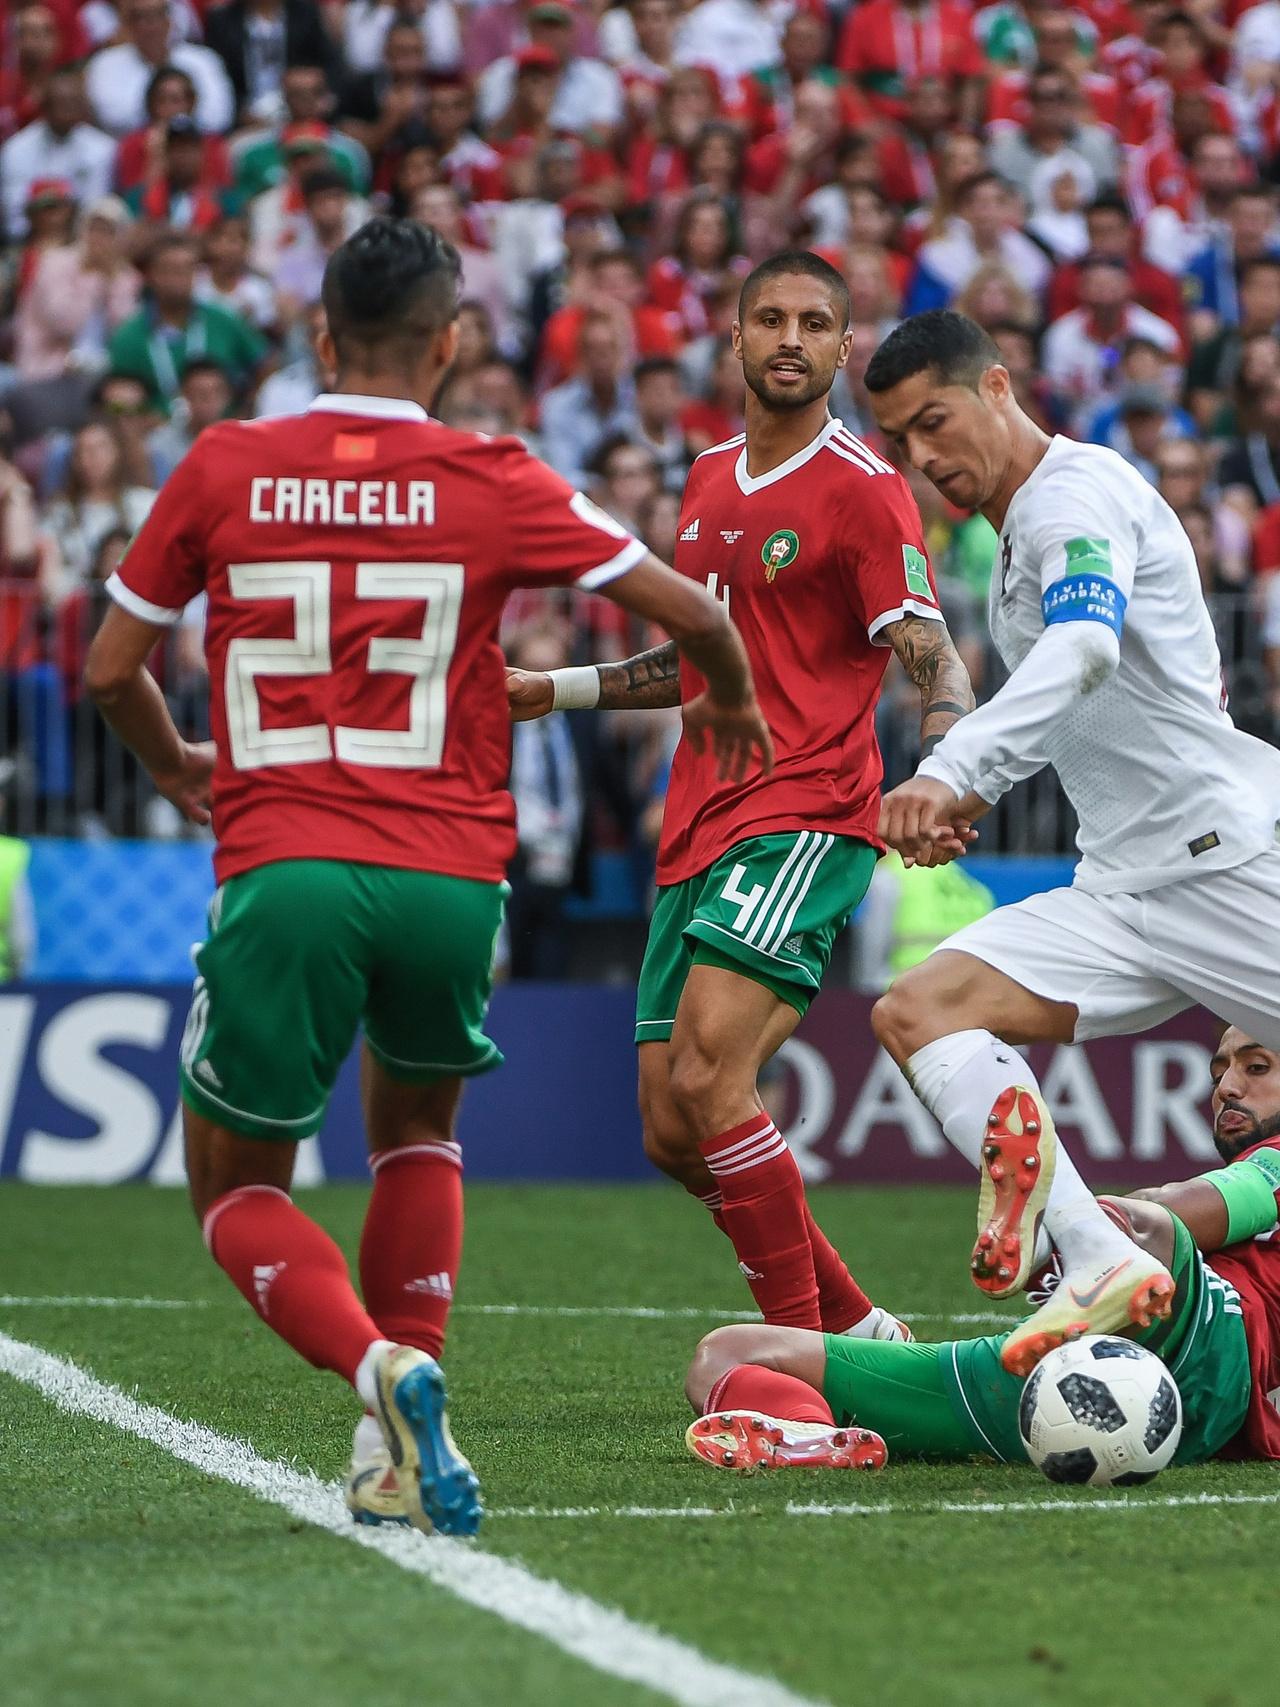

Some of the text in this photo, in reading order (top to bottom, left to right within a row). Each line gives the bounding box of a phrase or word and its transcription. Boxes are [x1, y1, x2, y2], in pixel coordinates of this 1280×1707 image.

[249, 477, 435, 526] CARCELA
[1087, 603, 1115, 621] FIFA
[224, 561, 464, 771] 23
[719, 863, 766, 932] 4
[757, 1037, 1218, 1184] QAAR
